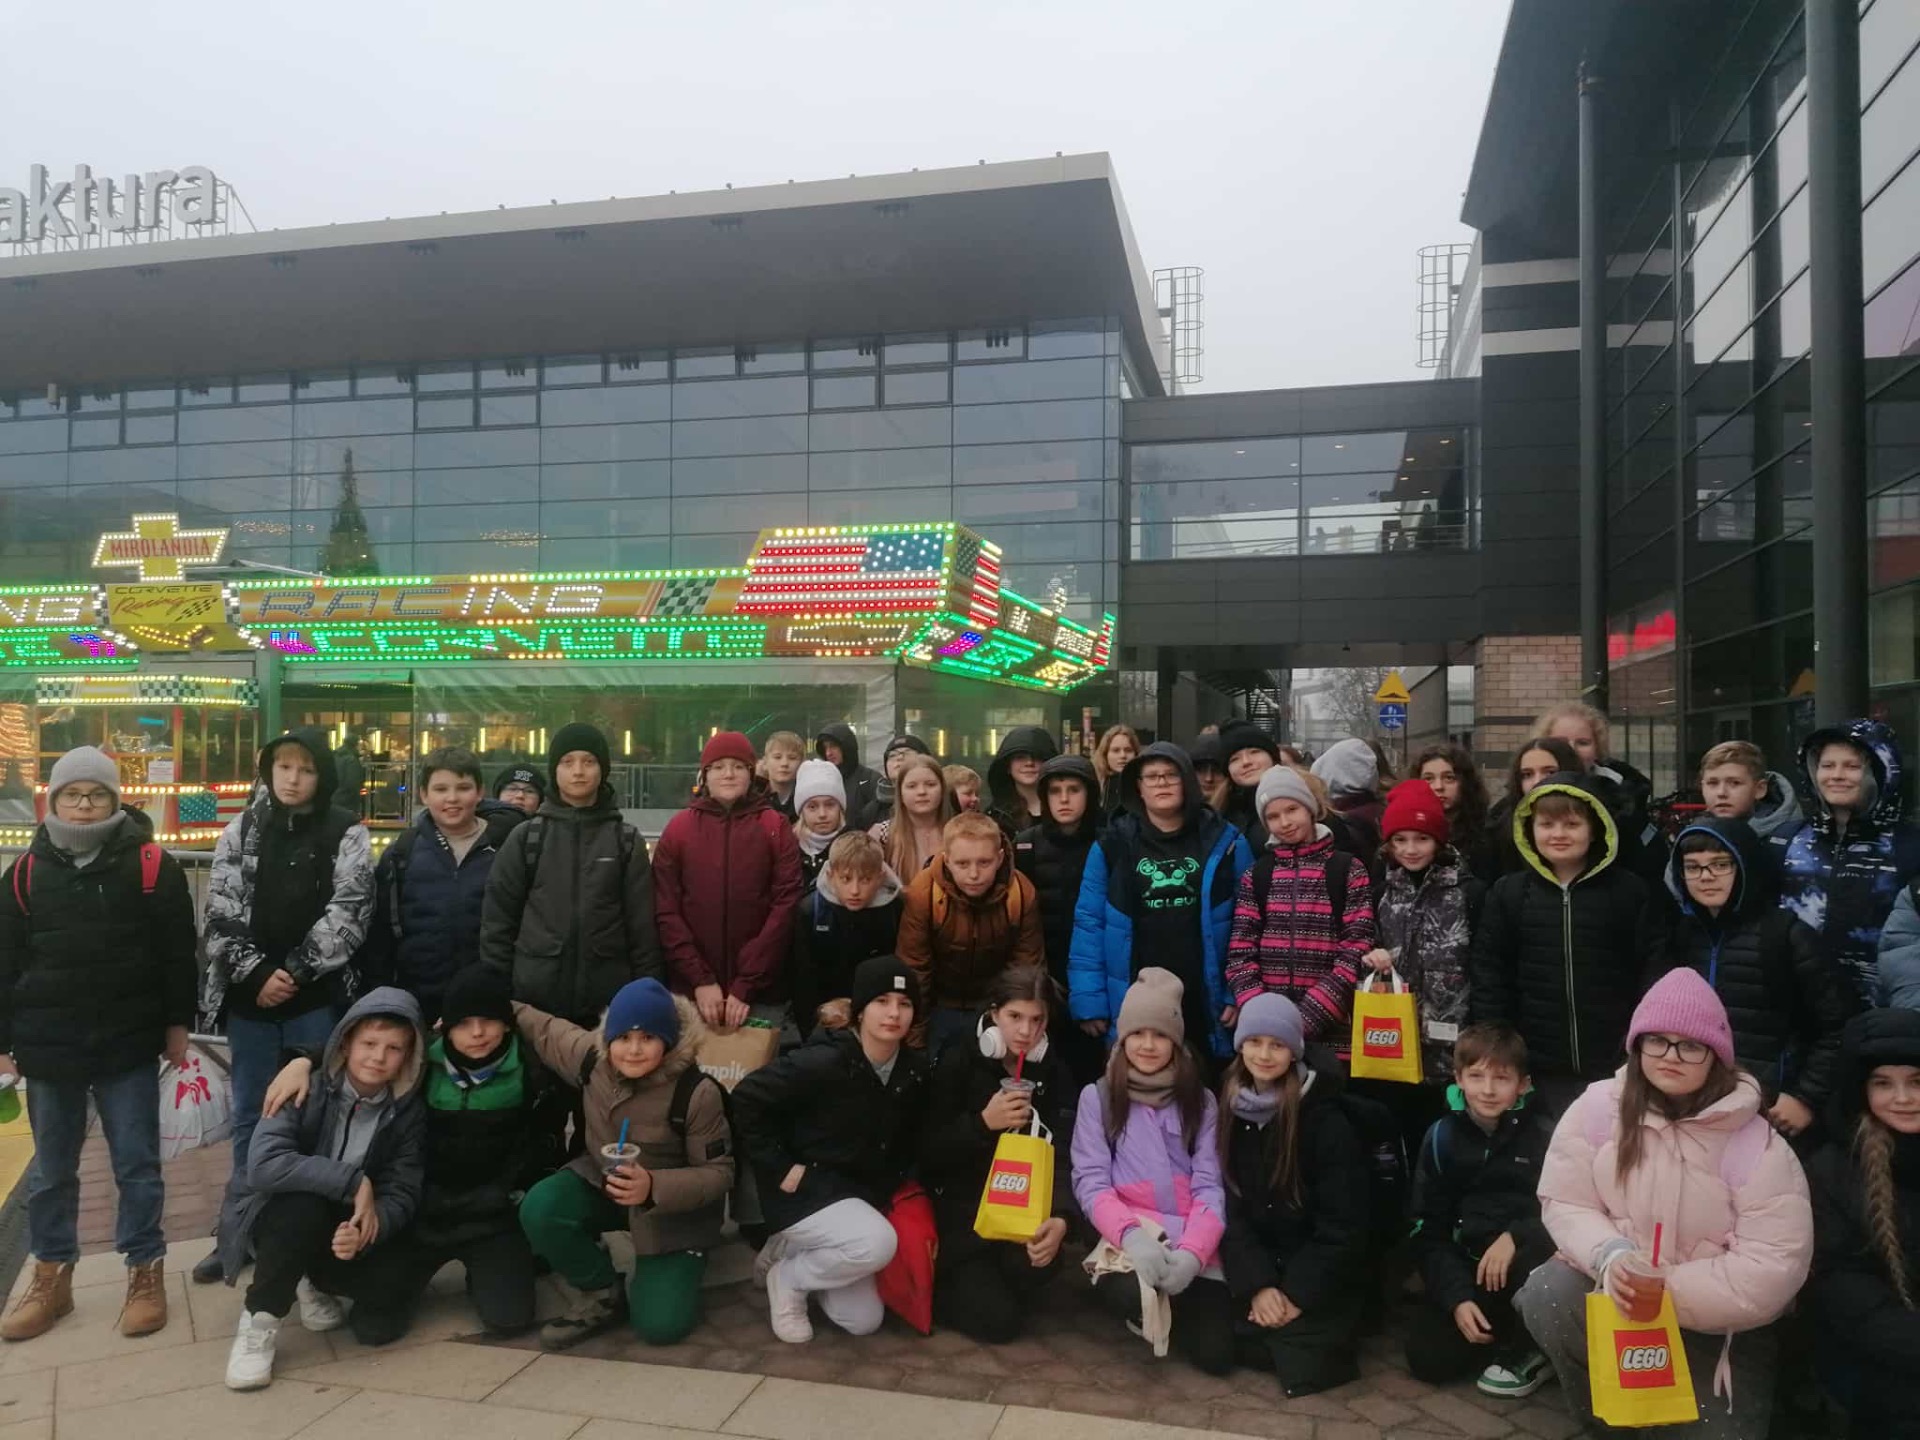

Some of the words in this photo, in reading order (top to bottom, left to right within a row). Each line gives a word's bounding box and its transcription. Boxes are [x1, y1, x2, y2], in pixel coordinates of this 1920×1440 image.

[110, 538, 211, 558] MIROLANDIA
[114, 584, 213, 595] CORVETTE
[257, 583, 605, 619] RACING
[1365, 1029, 1399, 1046] LEGO
[991, 1172, 1028, 1192] LEGO
[1622, 1346, 1669, 1370] LEGO
